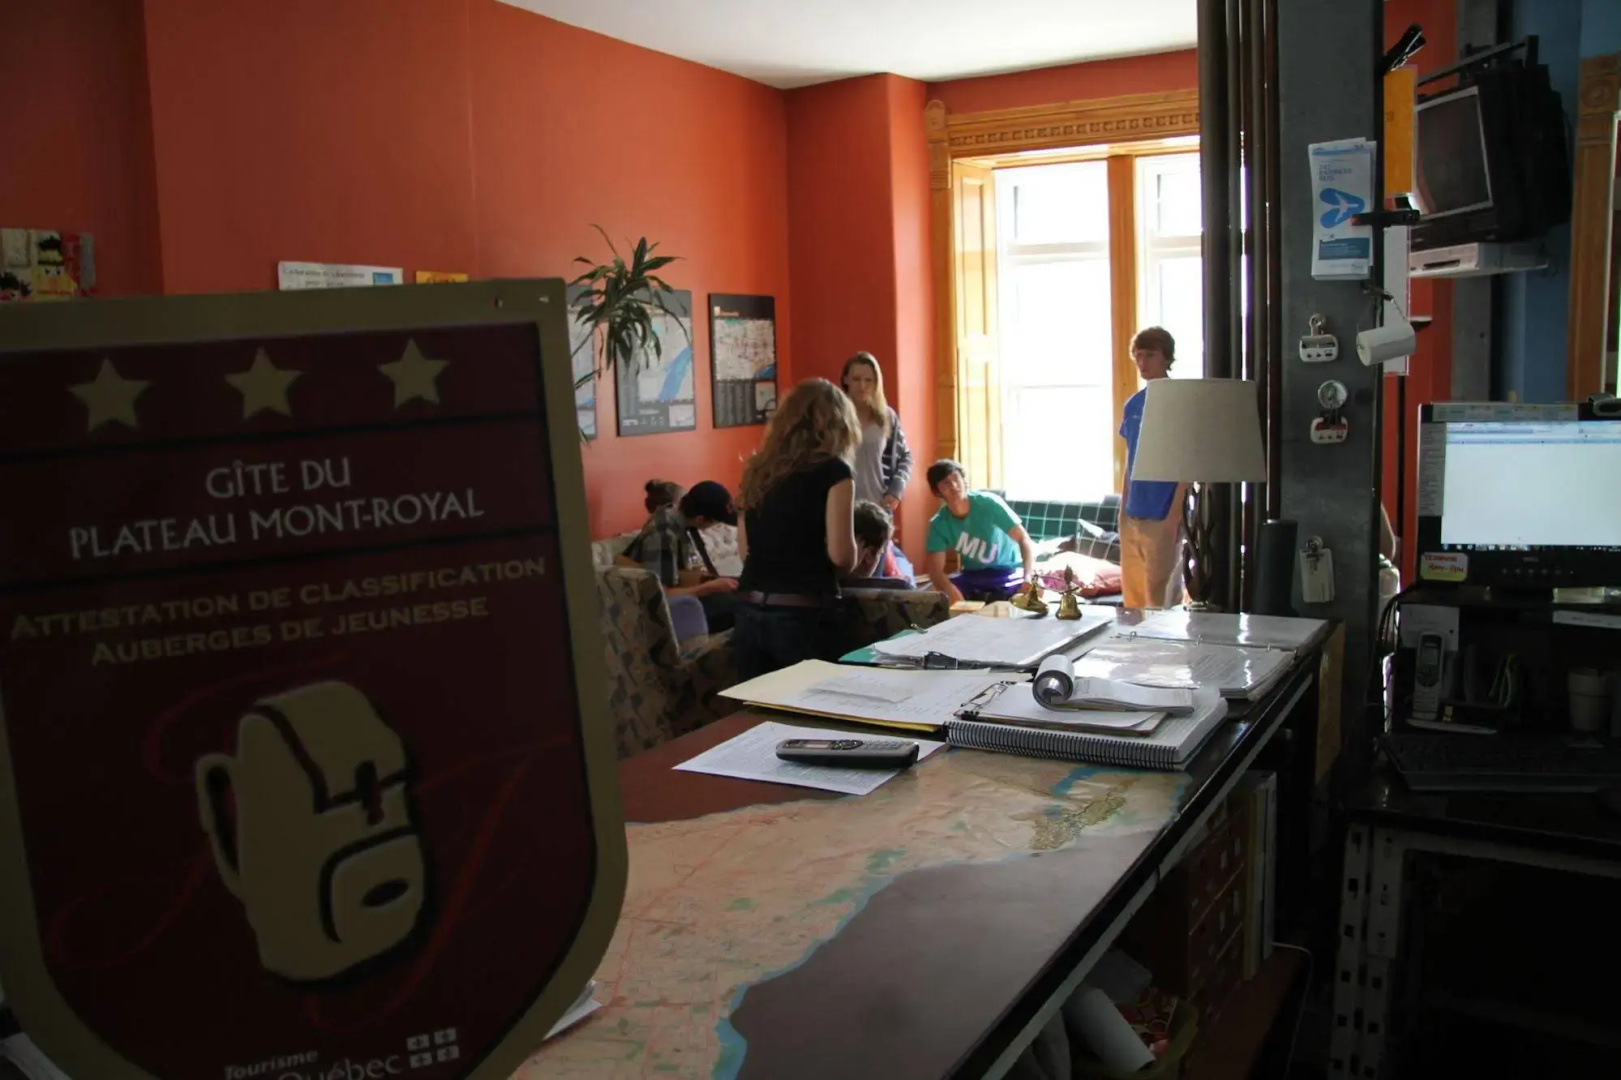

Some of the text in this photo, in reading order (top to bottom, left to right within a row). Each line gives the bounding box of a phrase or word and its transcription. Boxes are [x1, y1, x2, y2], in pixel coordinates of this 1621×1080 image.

[205, 457, 352, 499] GÎTE DU
[69, 487, 485, 561] PLATEAU MONT-ROYAL
[955, 531, 998, 564] MU
[9, 558, 546, 640] ATTESTATION DE CLASSIFICATION
[91, 597, 490, 667] AUBERGES DE JEUNESSE
[224, 1050, 319, 1080] Tourisme
